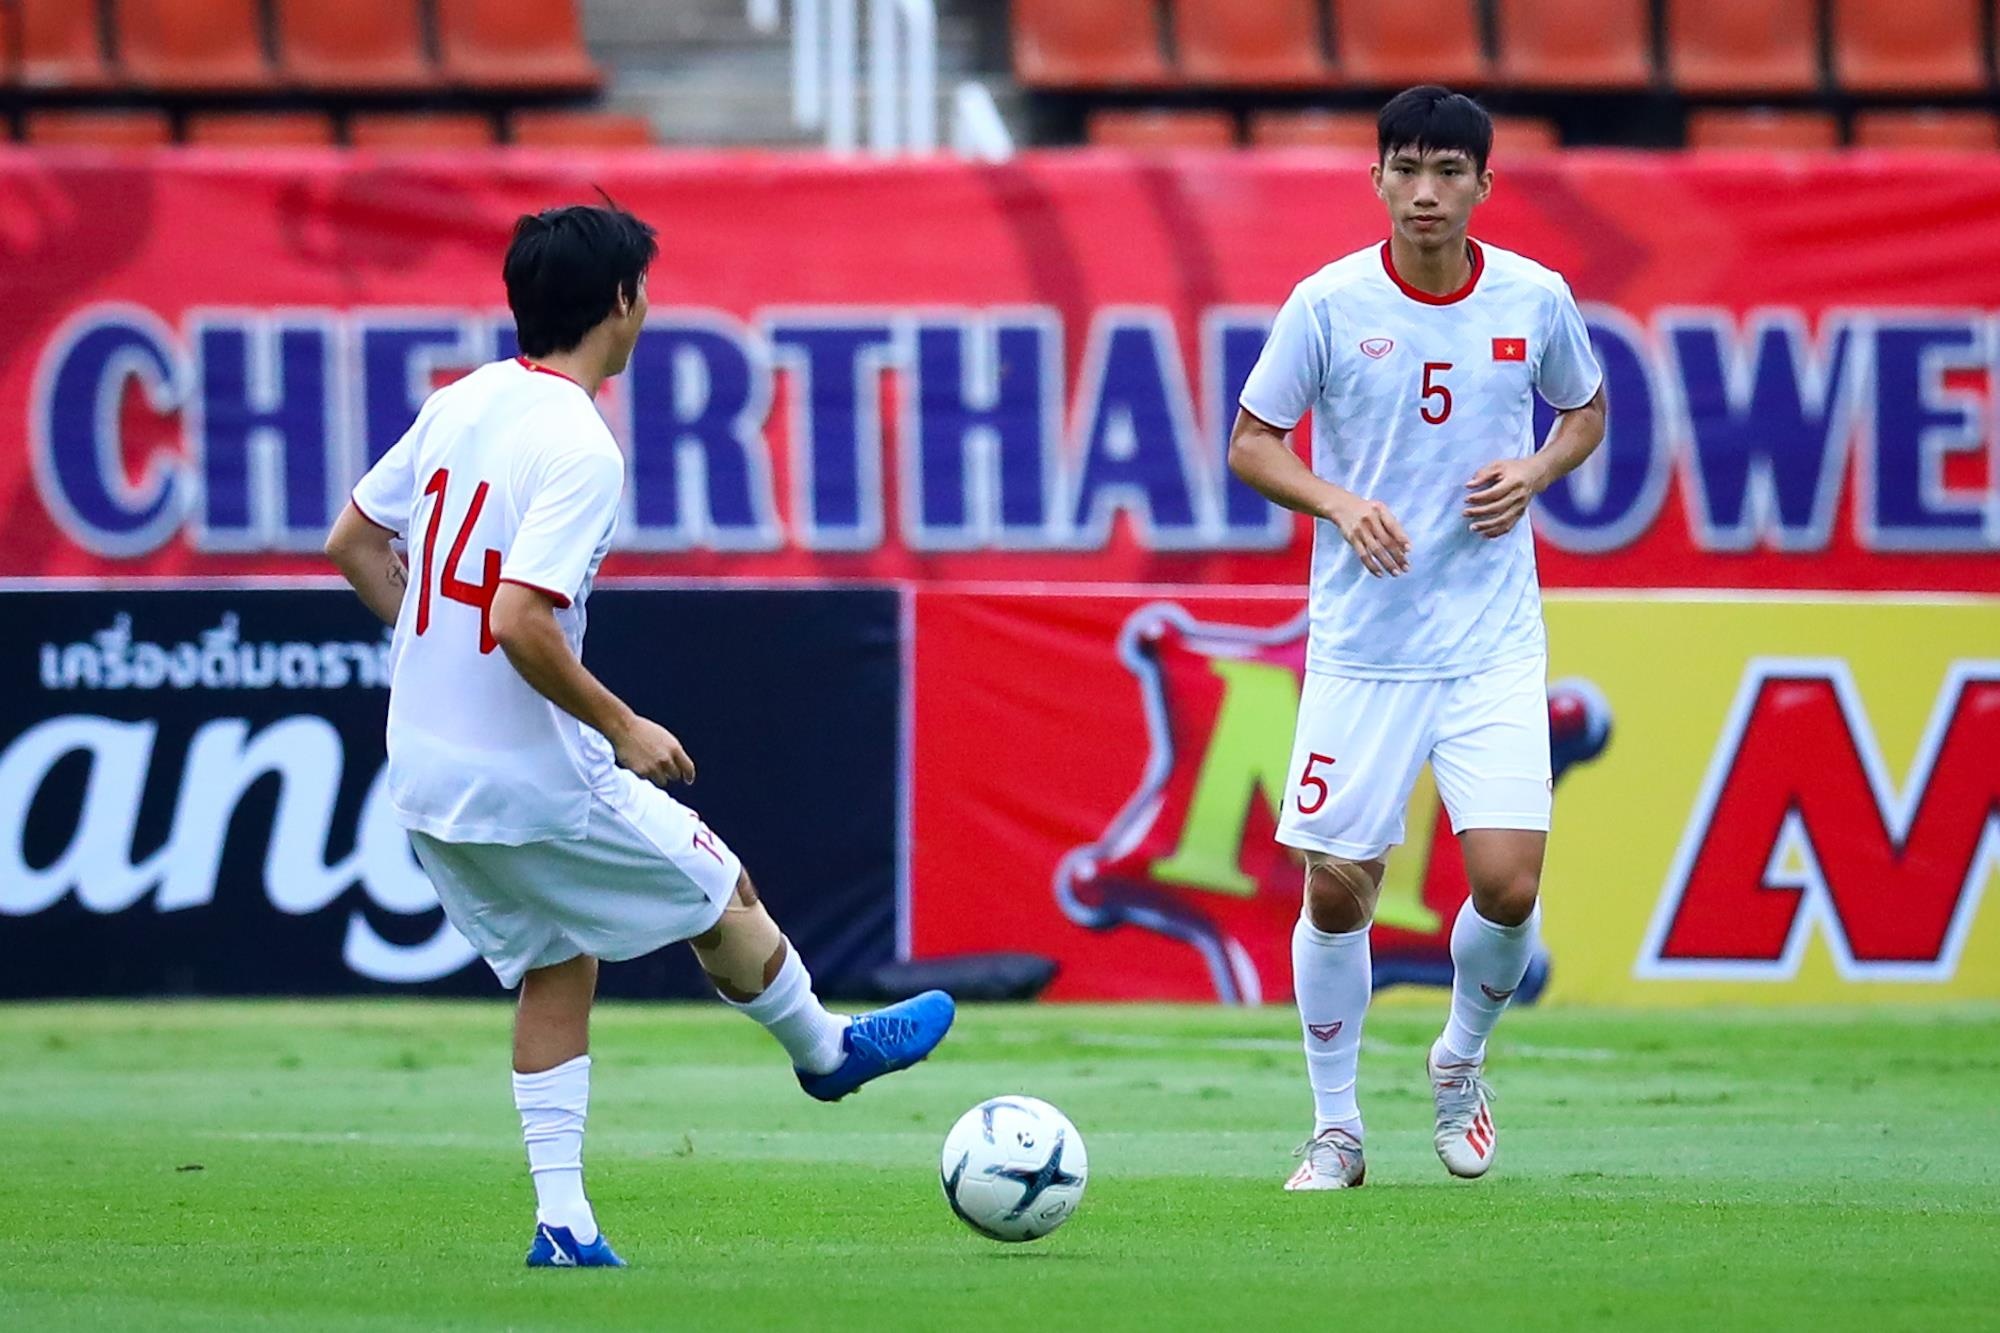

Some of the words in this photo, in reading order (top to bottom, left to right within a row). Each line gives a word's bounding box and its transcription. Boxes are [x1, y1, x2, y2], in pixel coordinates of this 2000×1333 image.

[32, 303, 1293, 556] CHERTHAI
[1530, 305, 2000, 554] OWE
[1420, 362, 1453, 424] 5
[415, 467, 501, 654] 14
[40, 611, 392, 690] เครื่องดื่มตรา
[1297, 751, 1336, 814] 5
